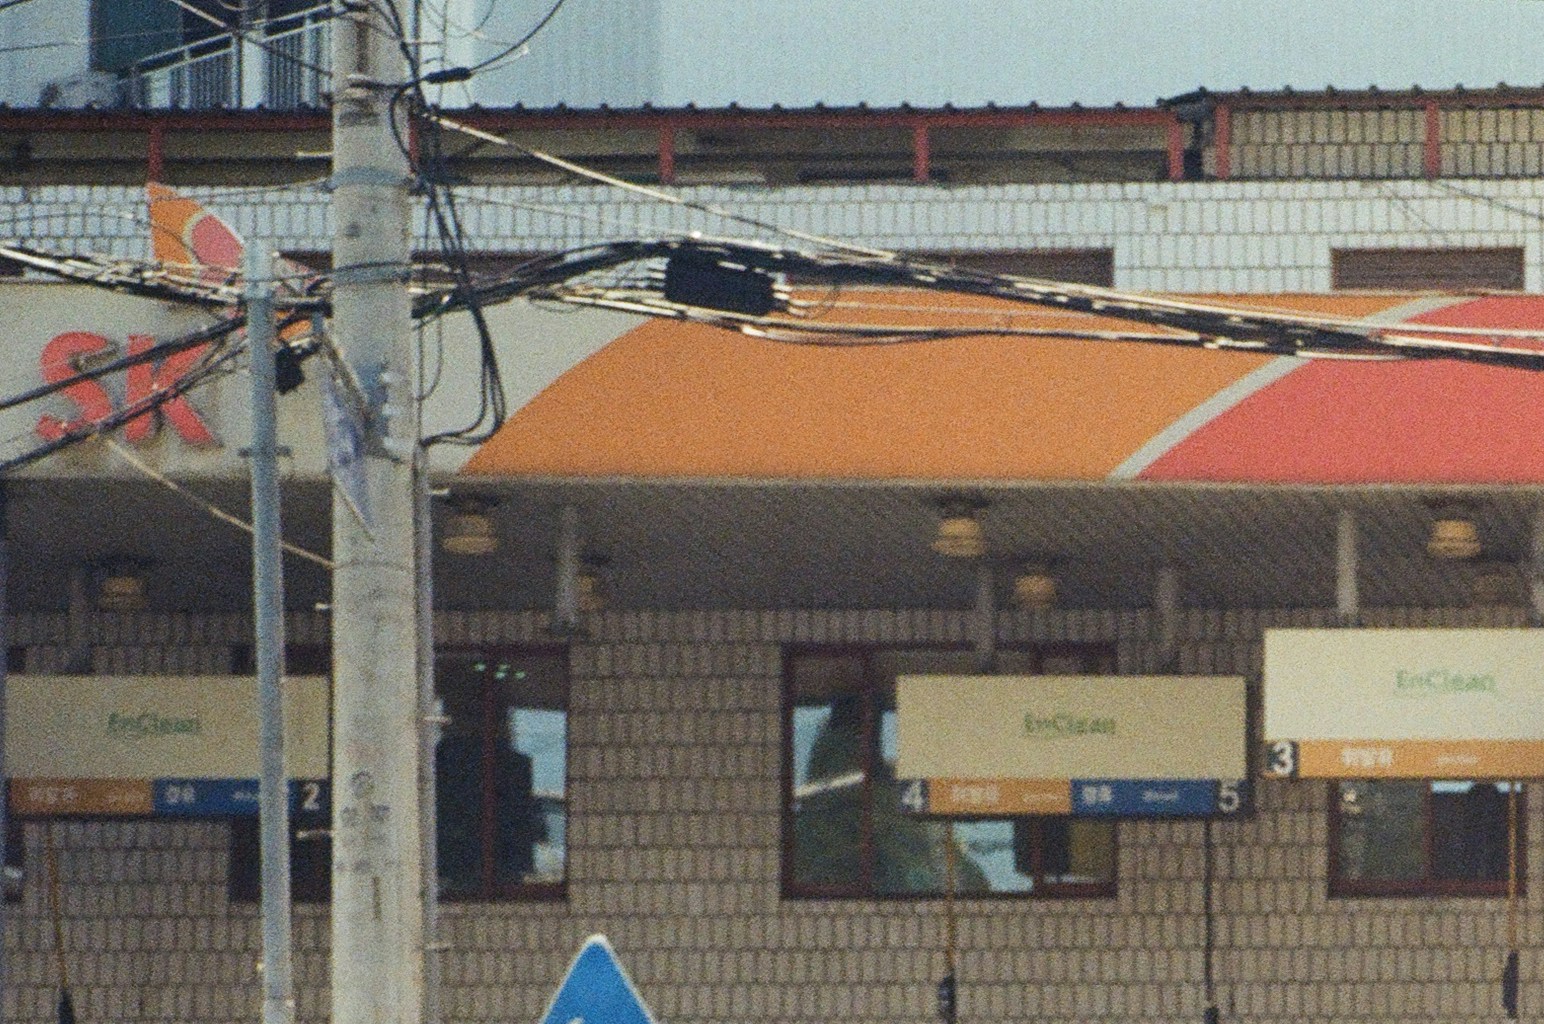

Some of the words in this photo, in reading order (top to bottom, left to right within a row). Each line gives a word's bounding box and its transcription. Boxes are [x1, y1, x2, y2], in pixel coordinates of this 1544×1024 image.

[37, 332, 218, 446] SK
[1397, 669, 1497, 692] EnClean
[1024, 713, 1116, 736] EnClean
[1274, 742, 1294, 775] 3
[302, 784, 320, 811] 2
[902, 782, 922, 811] 4
[1219, 781, 1240, 812] 5
